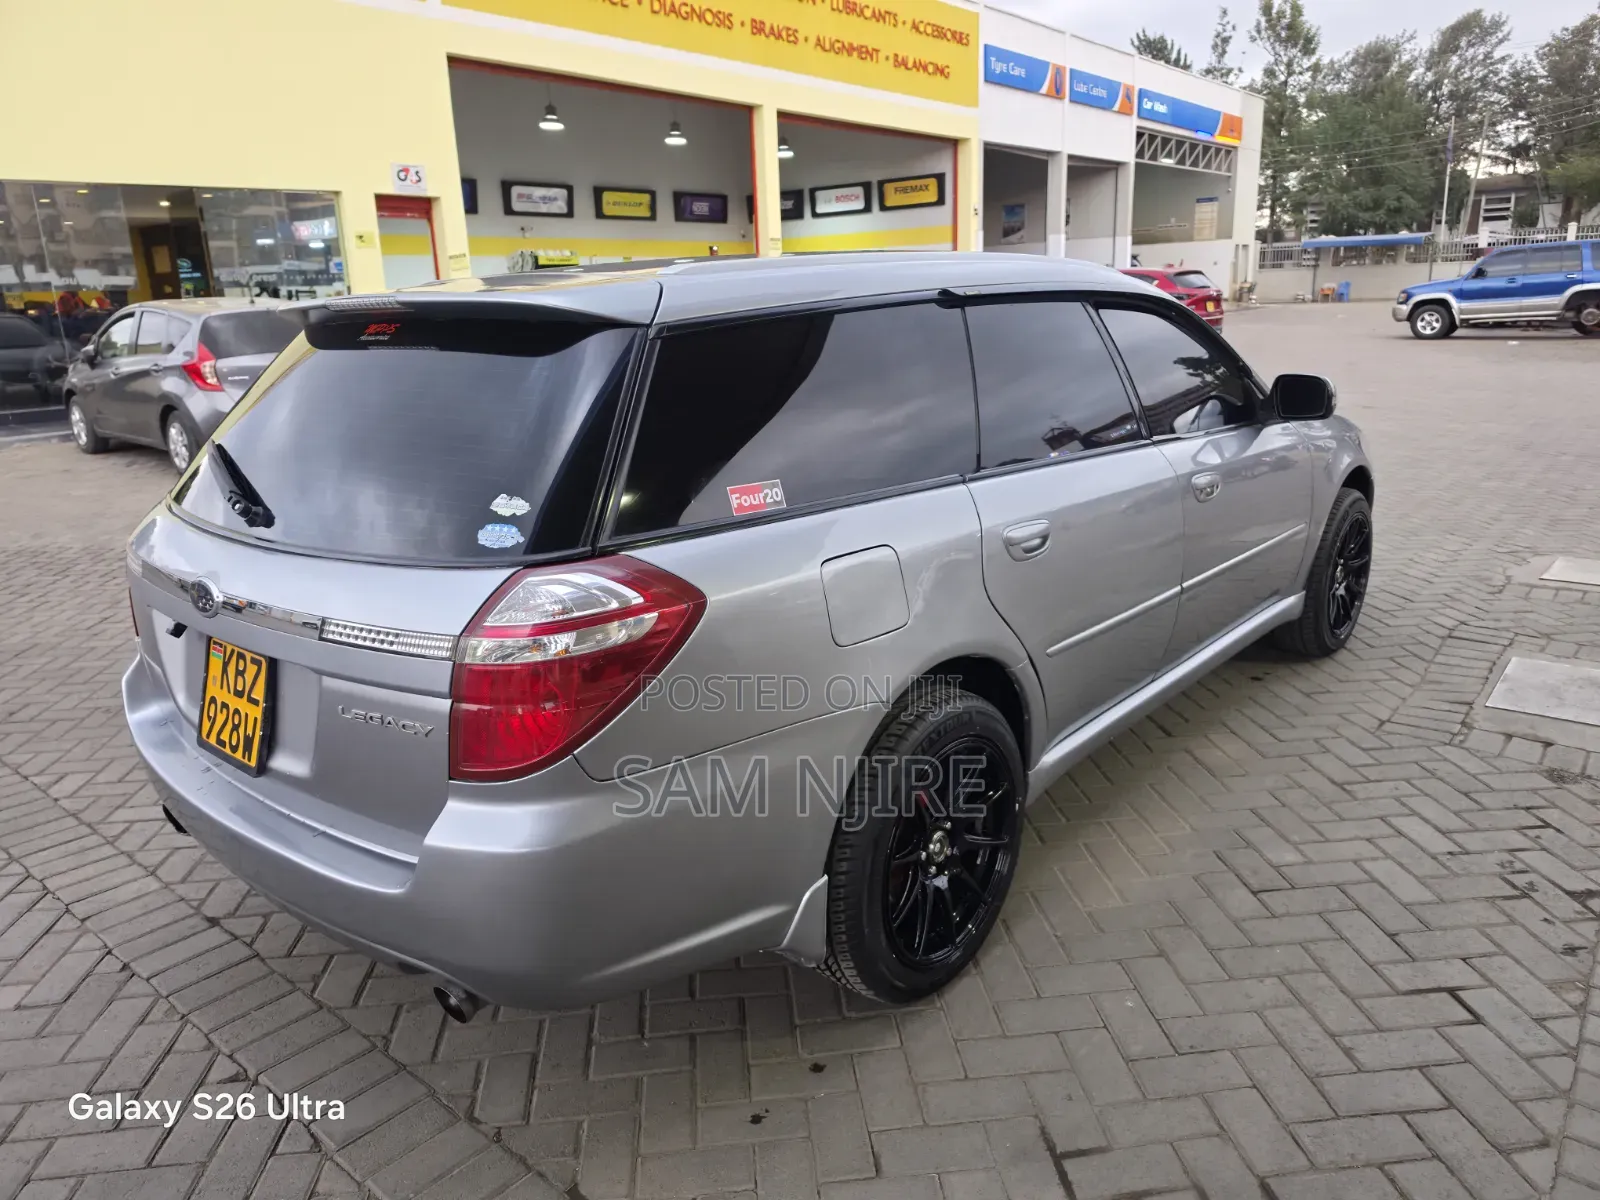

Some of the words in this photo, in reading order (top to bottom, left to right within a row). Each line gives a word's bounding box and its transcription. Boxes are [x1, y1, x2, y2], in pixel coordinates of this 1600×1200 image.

[830, 0, 898, 28] LUBRICANTS
[910, 18, 970, 47] ACCESSORIES
[650, 0, 734, 30] DIAGNOSIS
[750, 18, 799, 45] BRAKES
[814, 34, 881, 63] ALIGNMENT
[893, 53, 950, 80] BALANCING
[990, 57, 1007, 74] Tyre
[1008, 61, 1026, 78] Care
[1073, 80, 1088, 93] Lube
[1088, 83, 1108, 98] Centre
[1142, 98, 1153, 110] Car
[1154, 101, 1168, 113] Wash
[835, 193, 860, 204] BOSCH
[894, 184, 930, 195] FREMAX
[611, 200, 645, 208] DUNLOP
[731, 487, 782, 508] Four20
[219, 643, 263, 707] KBZ
[205, 695, 258, 762] 928W
[337, 704, 435, 738] LEGACY
